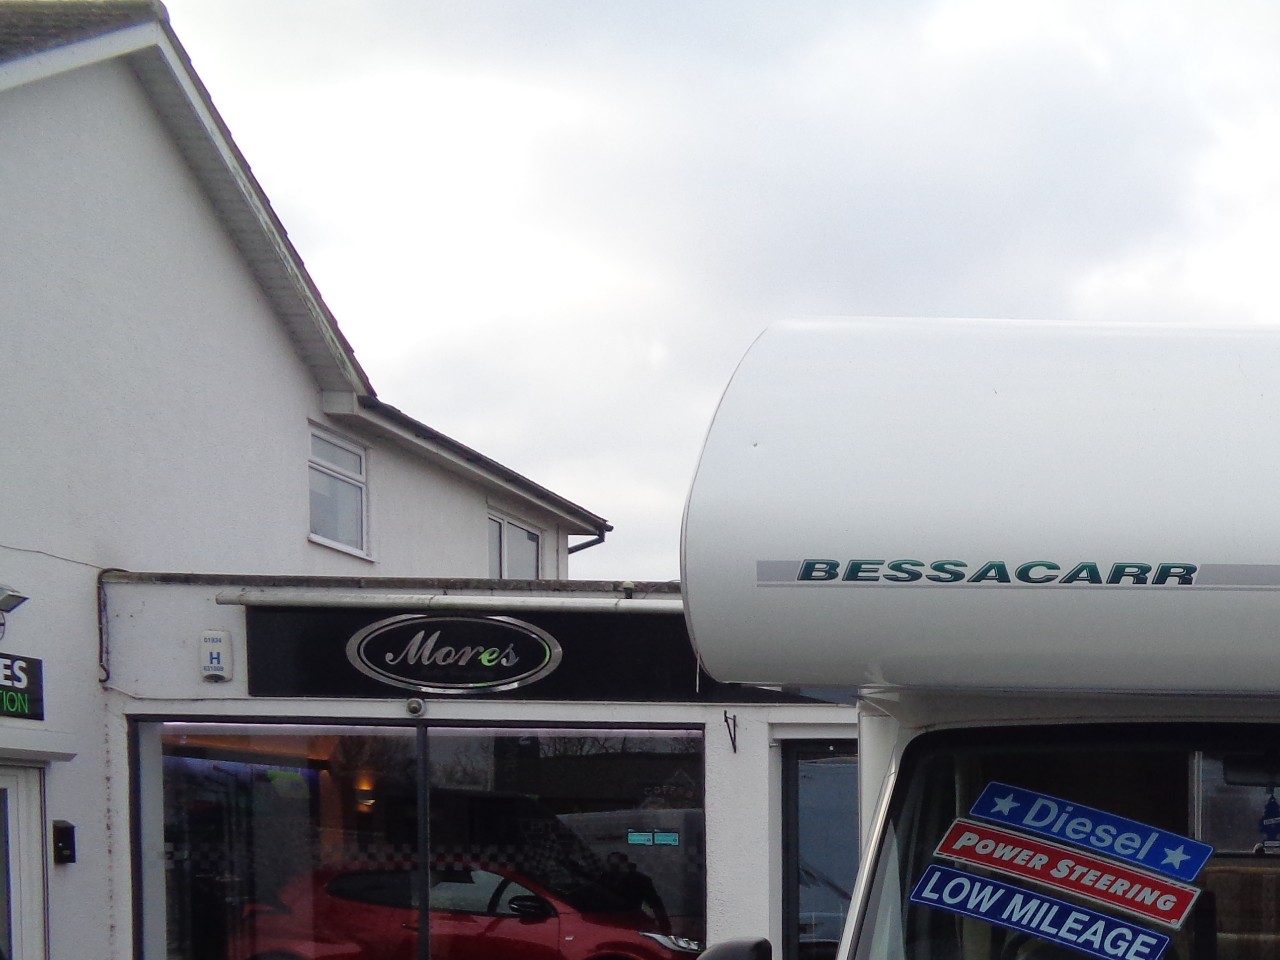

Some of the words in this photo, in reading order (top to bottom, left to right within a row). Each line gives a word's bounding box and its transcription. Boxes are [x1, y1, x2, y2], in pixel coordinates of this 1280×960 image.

[797, 558, 1198, 586] BESSACARR
[209, 651, 221, 665] H
[385, 630, 520, 667] Mores
[1023, 797, 1159, 860] Diesel
[921, 870, 1004, 913] LOW
[953, 831, 1052, 871] POWER
[1050, 858, 1177, 912] STEERING
